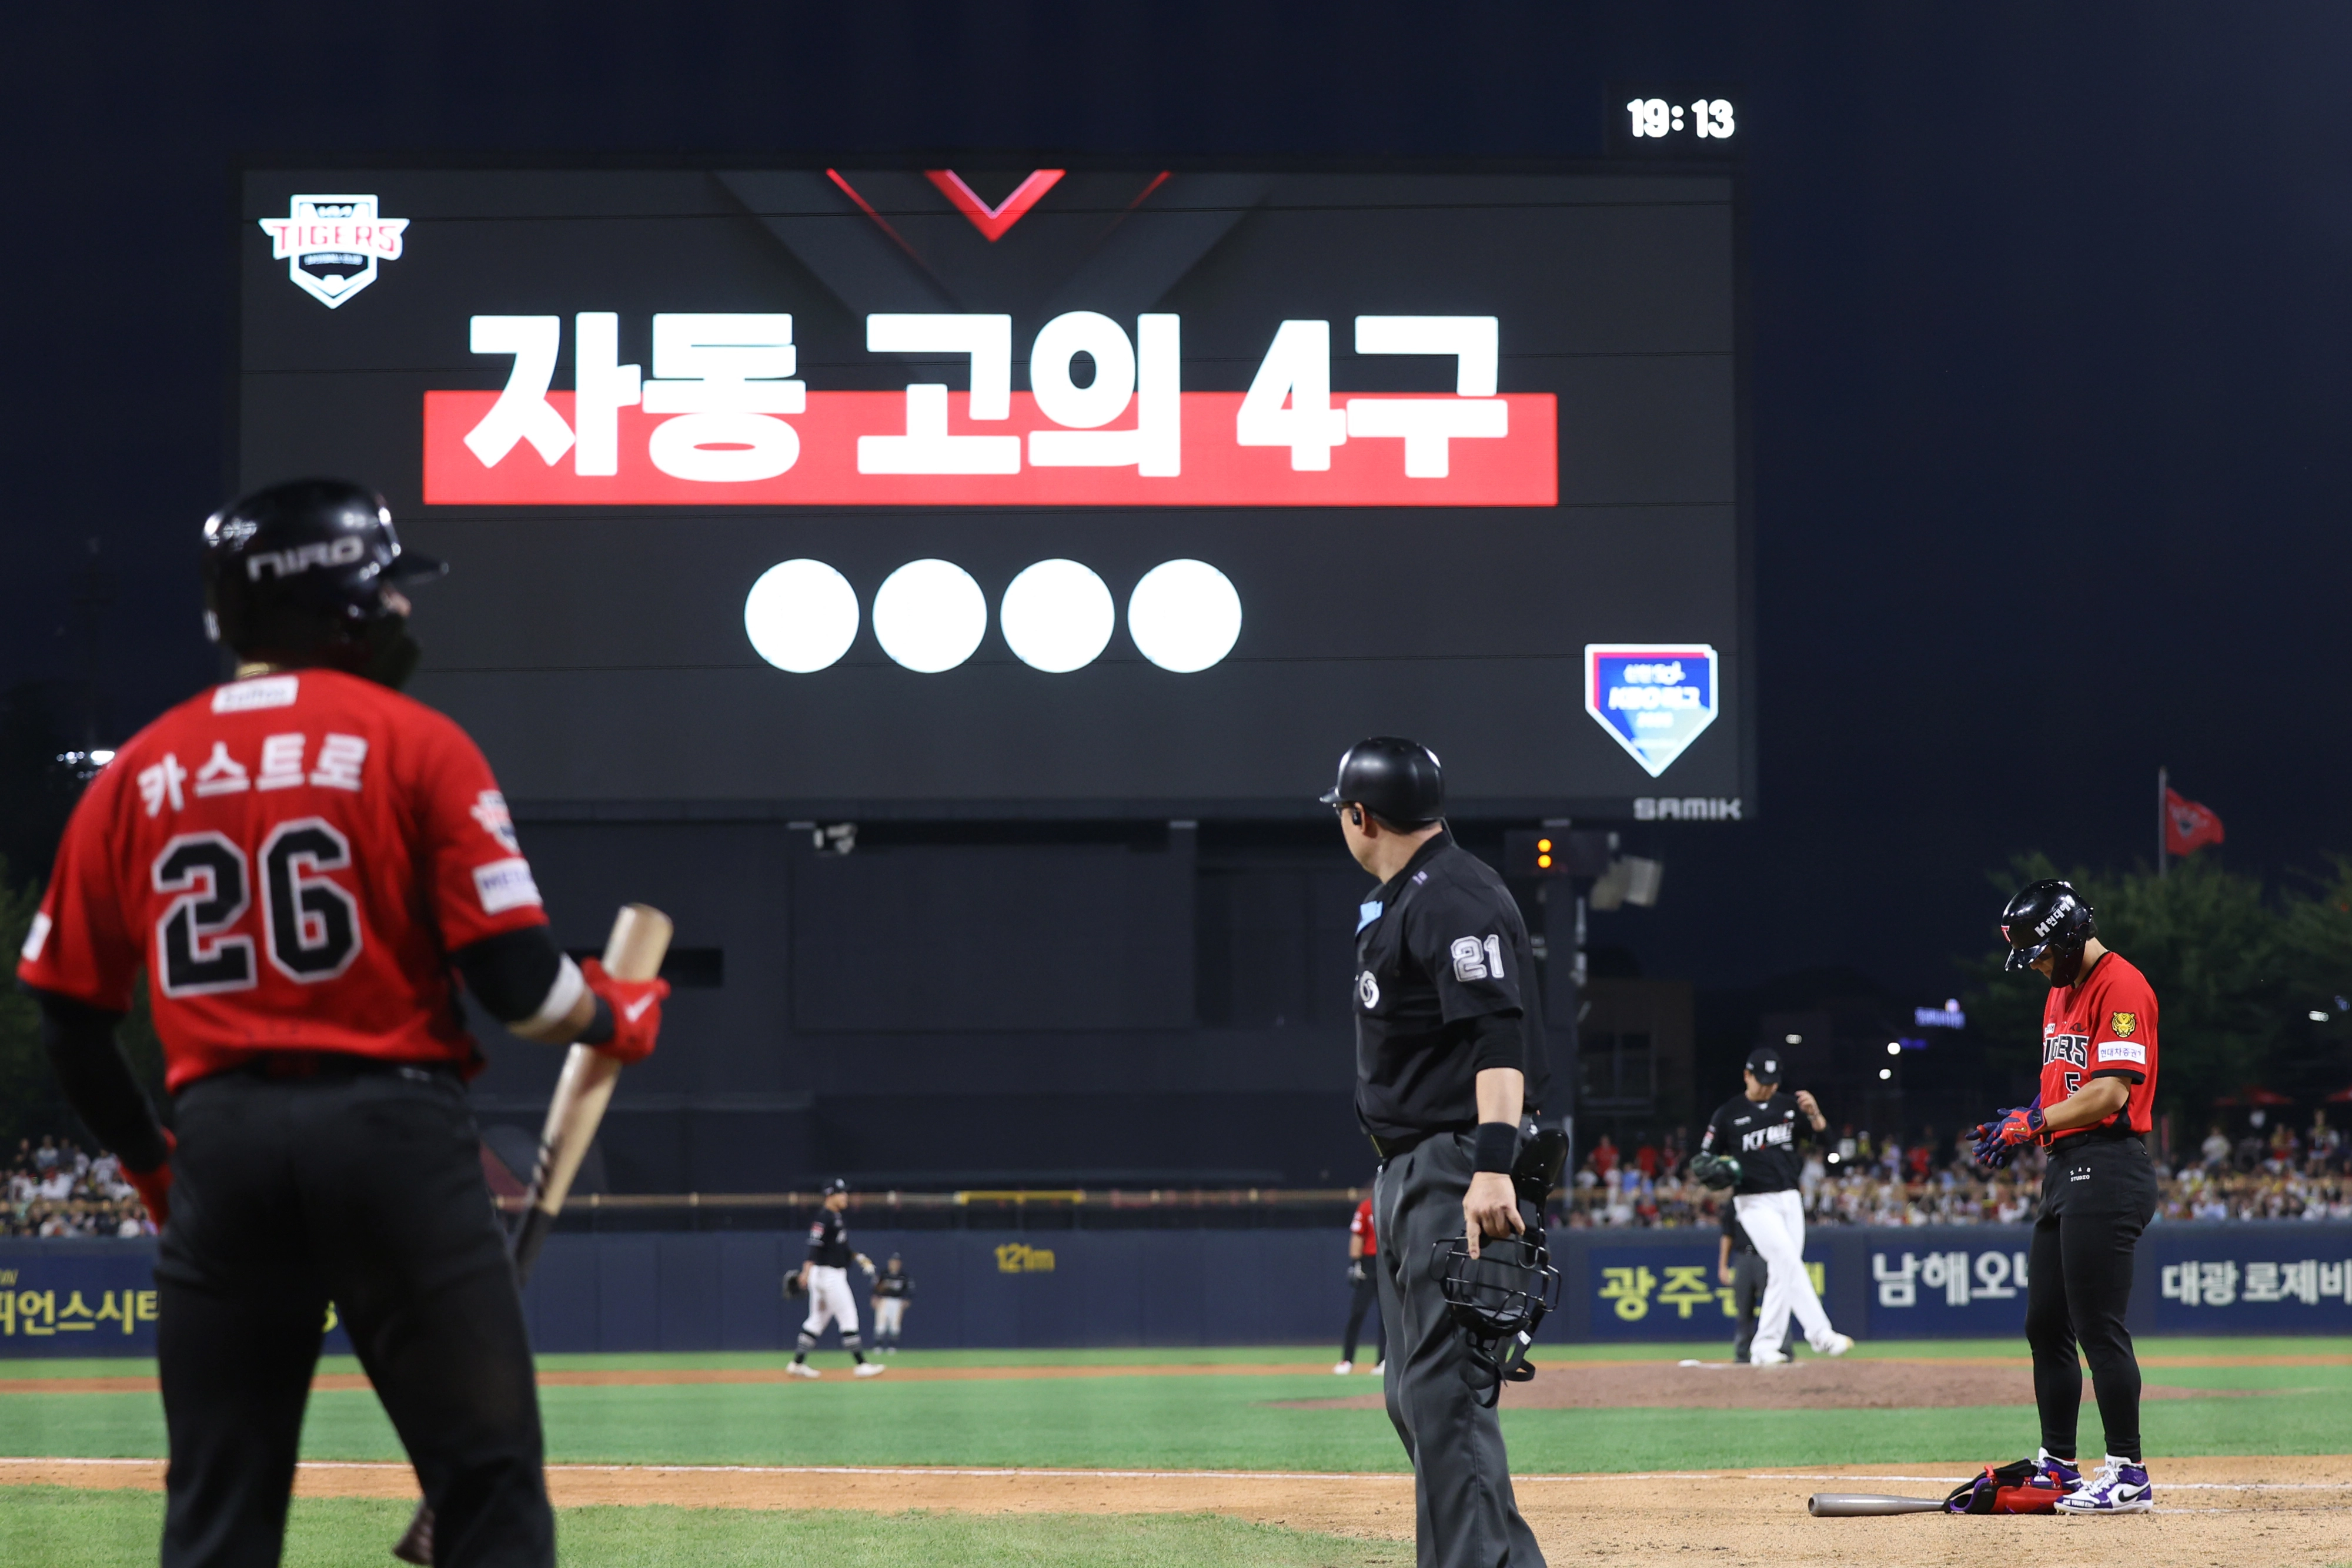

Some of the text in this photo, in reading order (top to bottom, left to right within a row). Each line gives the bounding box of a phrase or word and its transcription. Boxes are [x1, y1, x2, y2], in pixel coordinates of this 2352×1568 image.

[270, 225, 399, 253] TIGERS
[464, 311, 1508, 482] 자동 고의 4구
[137, 733, 368, 818] 카스트로
[1633, 797, 1742, 820] SAMIK
[151, 815, 363, 998] 26
[1450, 934, 1505, 982] 21
[2100, 1048, 2137, 1058] 현대차증권
[2064, 1072, 2081, 1101] 5
[995, 1242, 1055, 1273] 121m
[1872, 1251, 2028, 1307] 남해오
[2161, 1260, 2239, 1306] 대광
